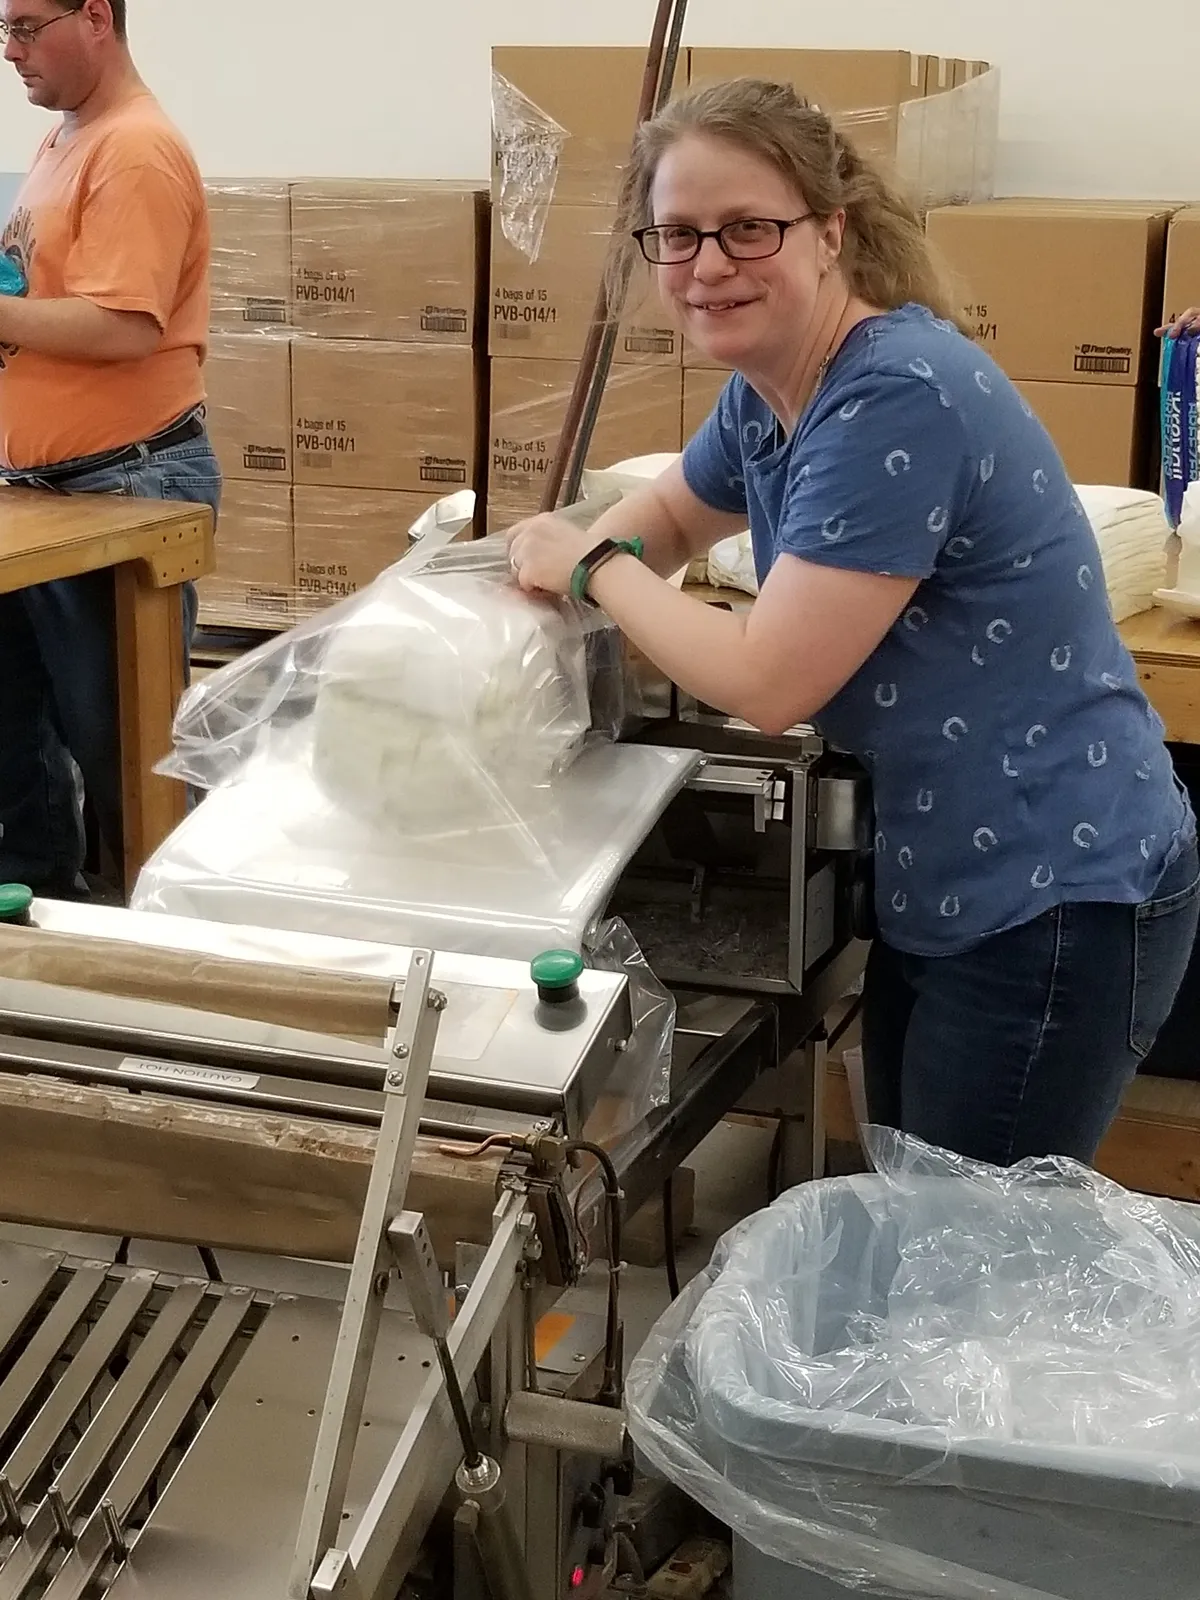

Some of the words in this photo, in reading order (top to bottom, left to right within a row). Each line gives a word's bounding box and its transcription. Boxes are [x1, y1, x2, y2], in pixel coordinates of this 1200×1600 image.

[296, 285, 355, 302] PVB-014/1
[494, 287, 500, 298] 4
[502, 288, 523, 302] bags
[525, 289, 535, 301] of
[538, 289, 548, 301] 15
[494, 304, 557, 323] PVB-014/1
[976, 304, 988, 318] 15
[296, 417, 302, 429] 4
[304, 418, 324, 432] bags
[325, 419, 334, 431] of
[337, 420, 347, 432] 15
[296, 433, 355, 453] PVB-014/1
[494, 438, 500, 449] 4
[502, 438, 523, 453] bags
[524, 441, 534, 452] of
[536, 441, 546, 453] 15
[299, 562, 305, 573] 4
[327, 564, 336, 576] of
[338, 565, 348, 576] 15
[139, 1062, 169, 1073] HOT
[173, 1068, 243, 1084] CAUTION
